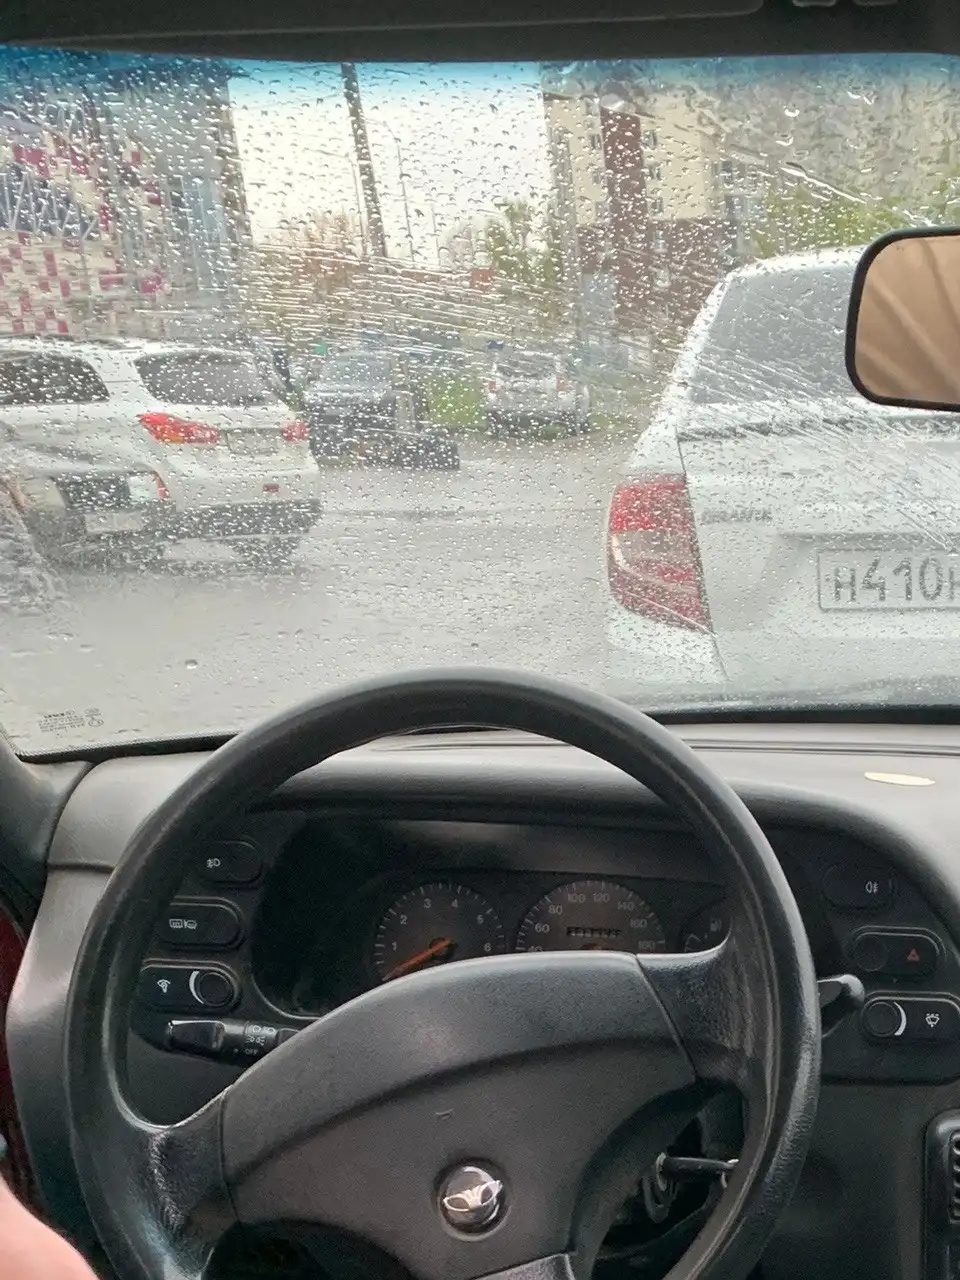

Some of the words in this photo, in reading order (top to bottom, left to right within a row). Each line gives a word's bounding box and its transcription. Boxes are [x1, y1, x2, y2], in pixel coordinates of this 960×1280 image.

[424, 898, 432, 909] 3
[593, 893, 611, 903] 120
[451, 899, 459, 909] 4
[548, 904, 563, 915] 80
[400, 914, 408, 925] 2
[535, 922, 550, 933] 60
[483, 942, 492, 953] 6
